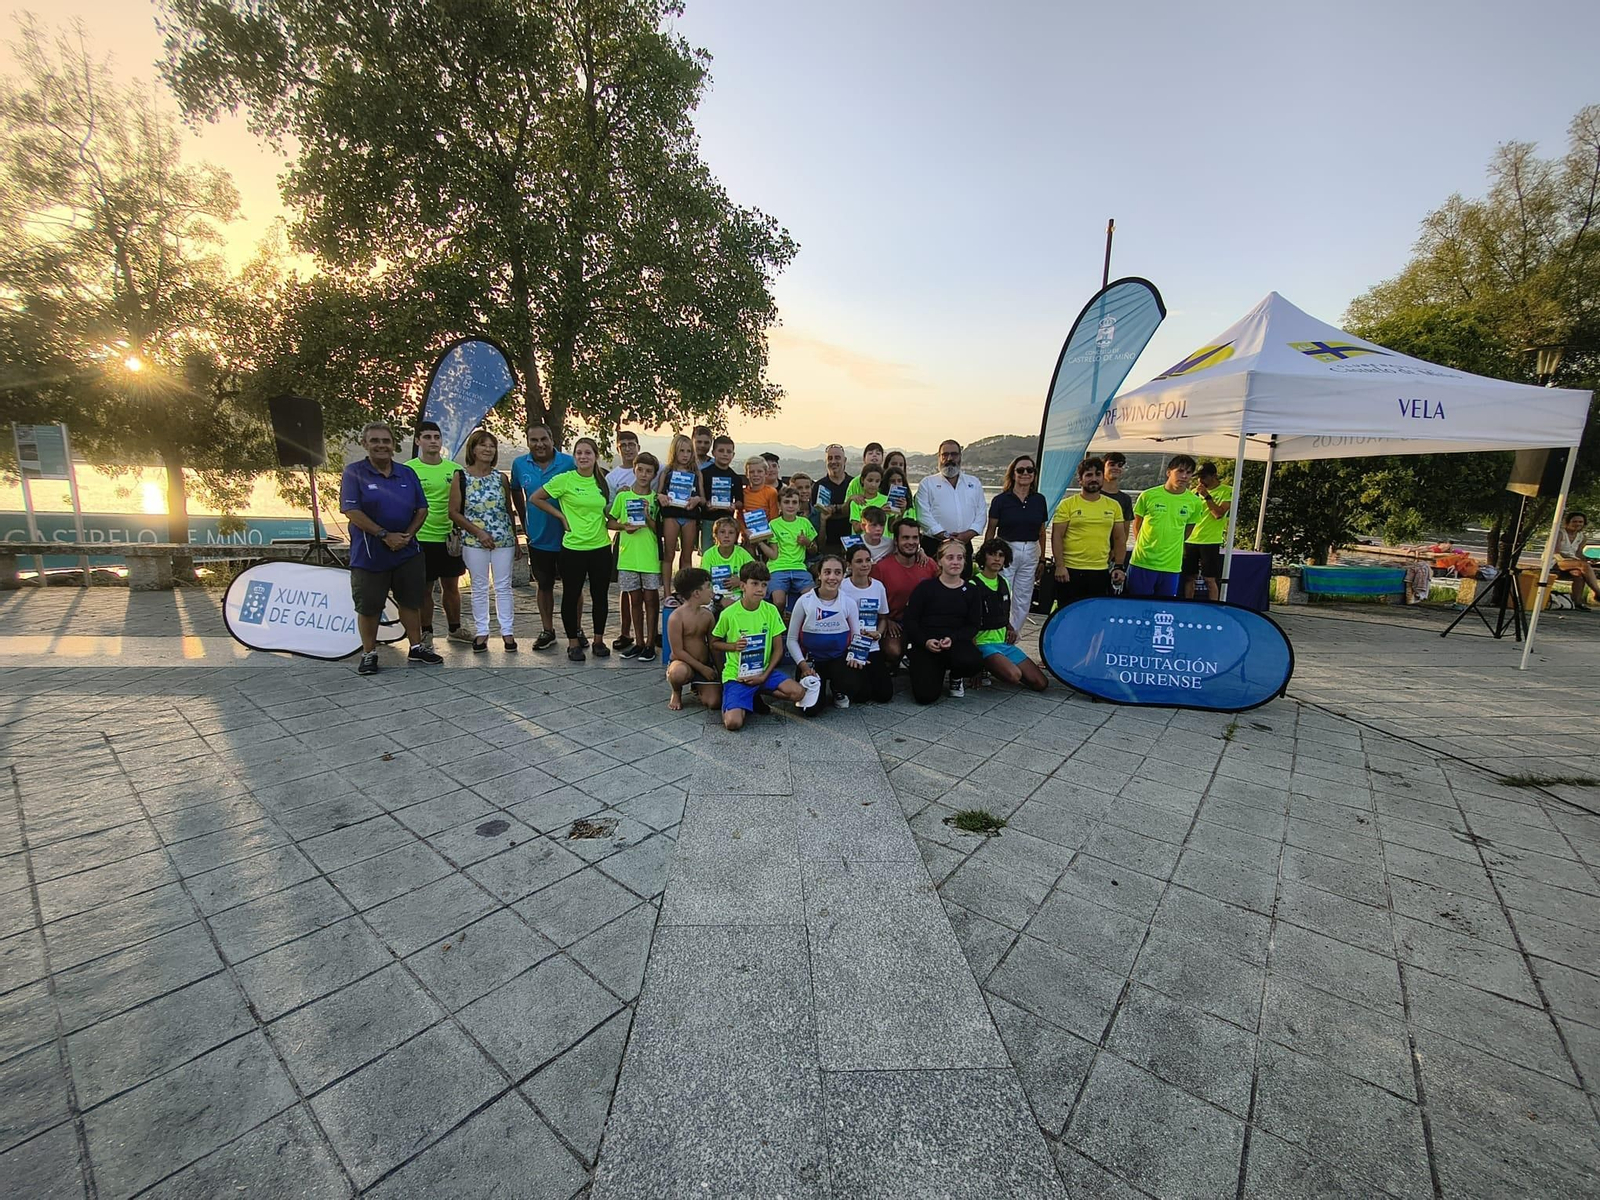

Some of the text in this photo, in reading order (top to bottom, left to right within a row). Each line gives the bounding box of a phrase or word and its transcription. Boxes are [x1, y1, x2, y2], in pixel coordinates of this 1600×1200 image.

[1068, 351, 1136, 364] CASTRELO DE MIÑO
[1398, 398, 1446, 420] VELA
[275, 588, 328, 609] XUNTA
[269, 607, 356, 635] DE GALICIA
[1105, 653, 1218, 674] DEPUTACIÓN
[1119, 670, 1202, 689] OURENSE
